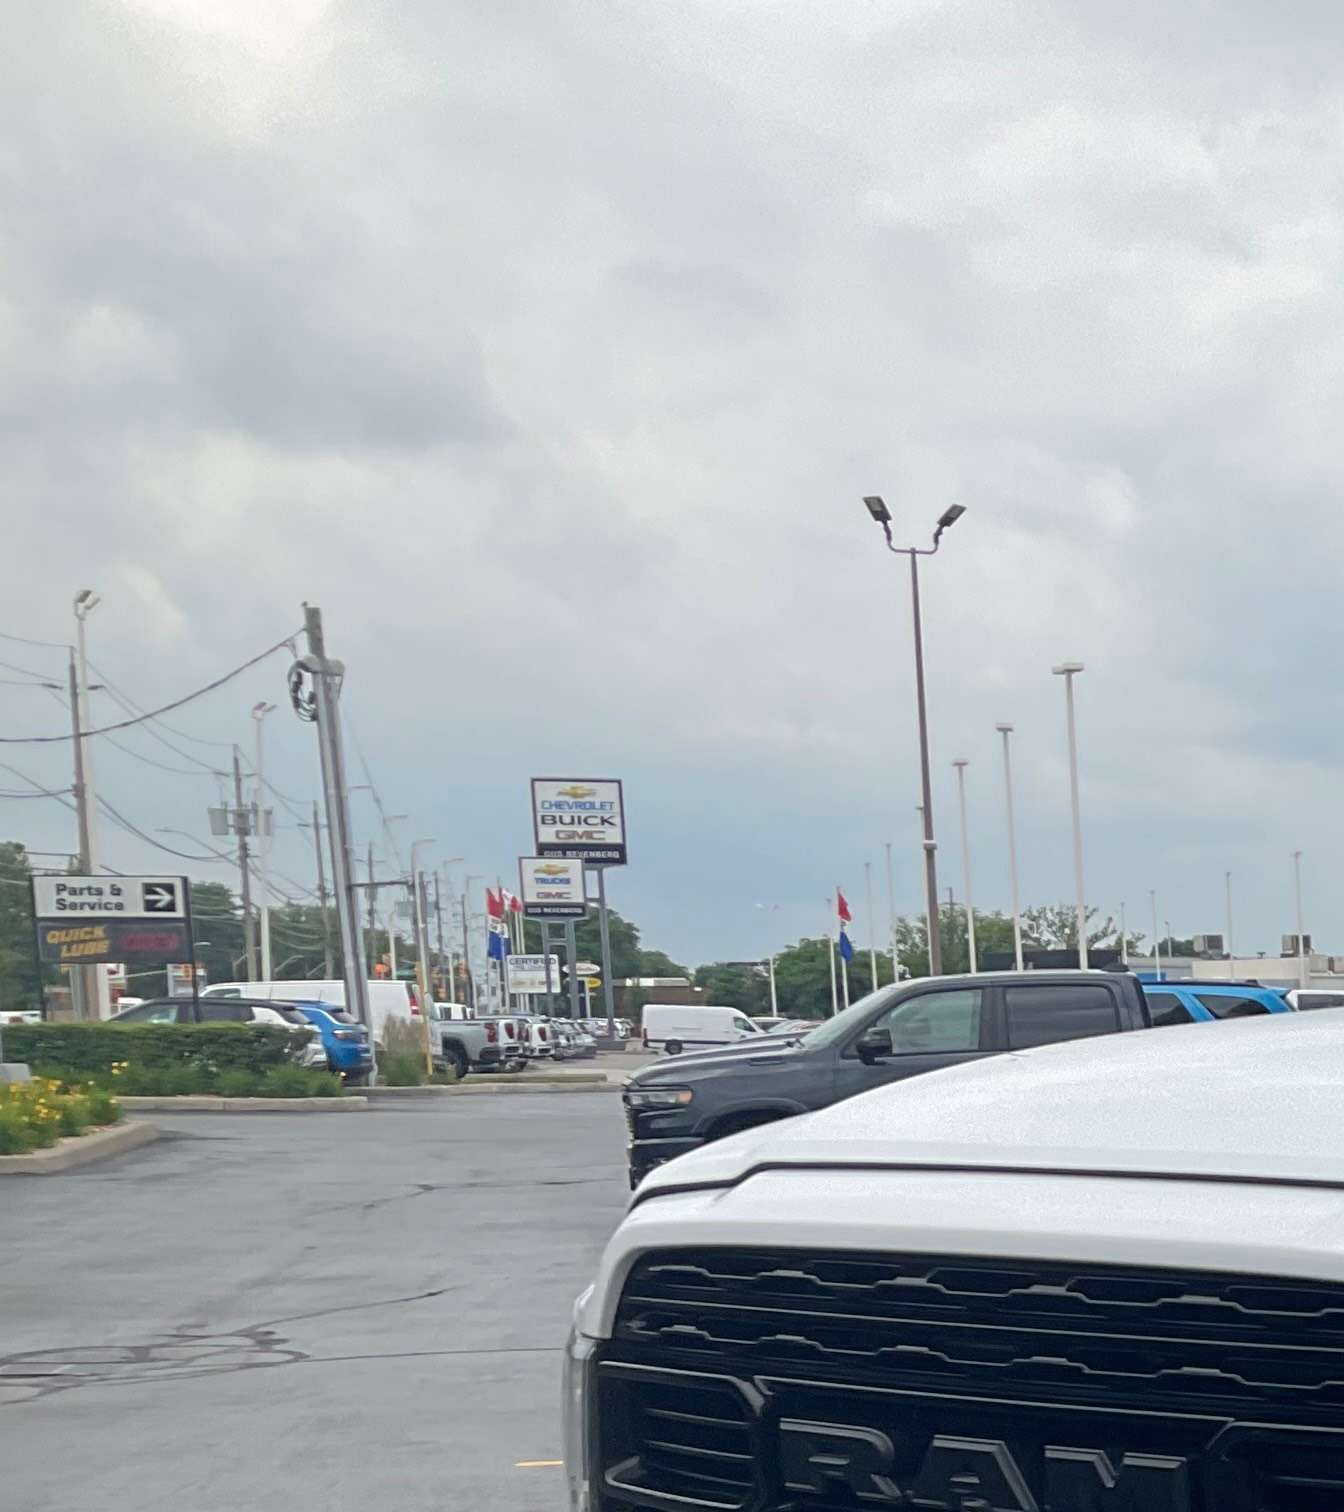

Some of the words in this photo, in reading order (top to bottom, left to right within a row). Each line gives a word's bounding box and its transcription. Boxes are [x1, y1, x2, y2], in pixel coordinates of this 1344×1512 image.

[541, 800, 615, 811] CHEVROLET
[541, 814, 617, 827] BUICK
[555, 829, 606, 841] GMC
[55, 883, 104, 897] Parts
[110, 883, 122, 897] &
[536, 891, 572, 900] GMC
[55, 898, 124, 911] Service
[47, 926, 106, 945] QUICK
[60, 939, 110, 958] LUBE
